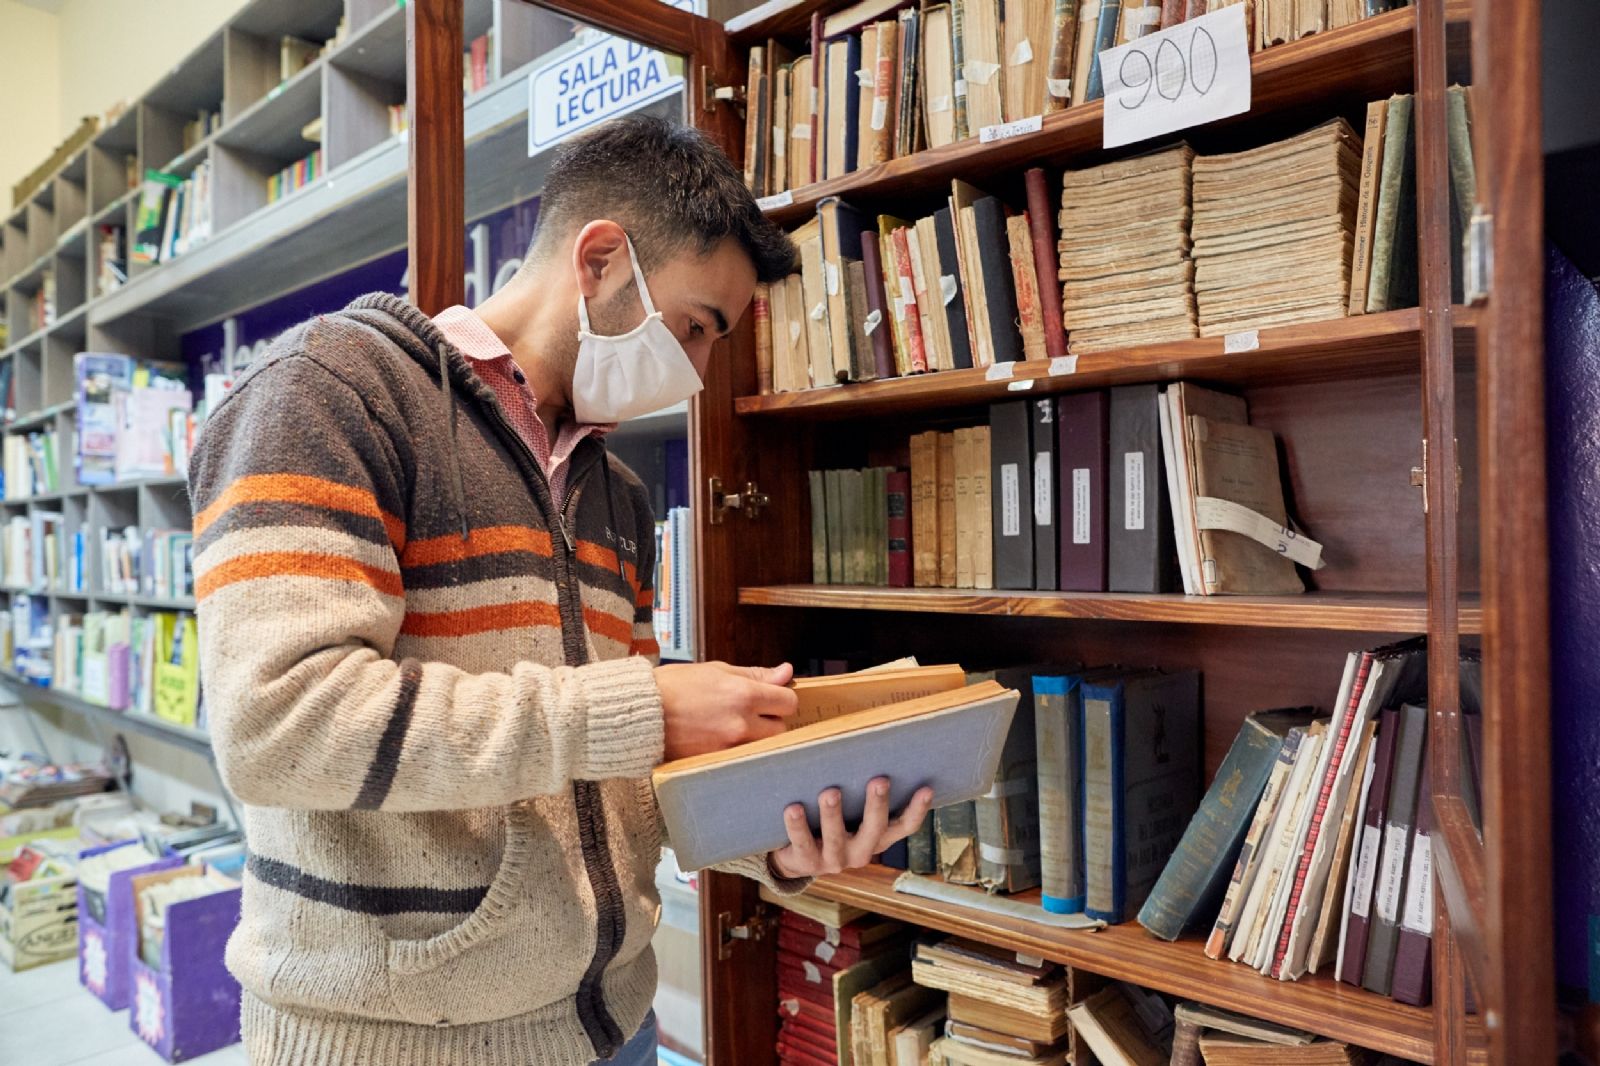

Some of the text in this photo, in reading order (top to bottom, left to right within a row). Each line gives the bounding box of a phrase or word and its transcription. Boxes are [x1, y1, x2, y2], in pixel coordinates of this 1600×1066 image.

[556, 59, 661, 128] LECTURA
[558, 47, 618, 96] SALA
[1119, 26, 1218, 110] 900
